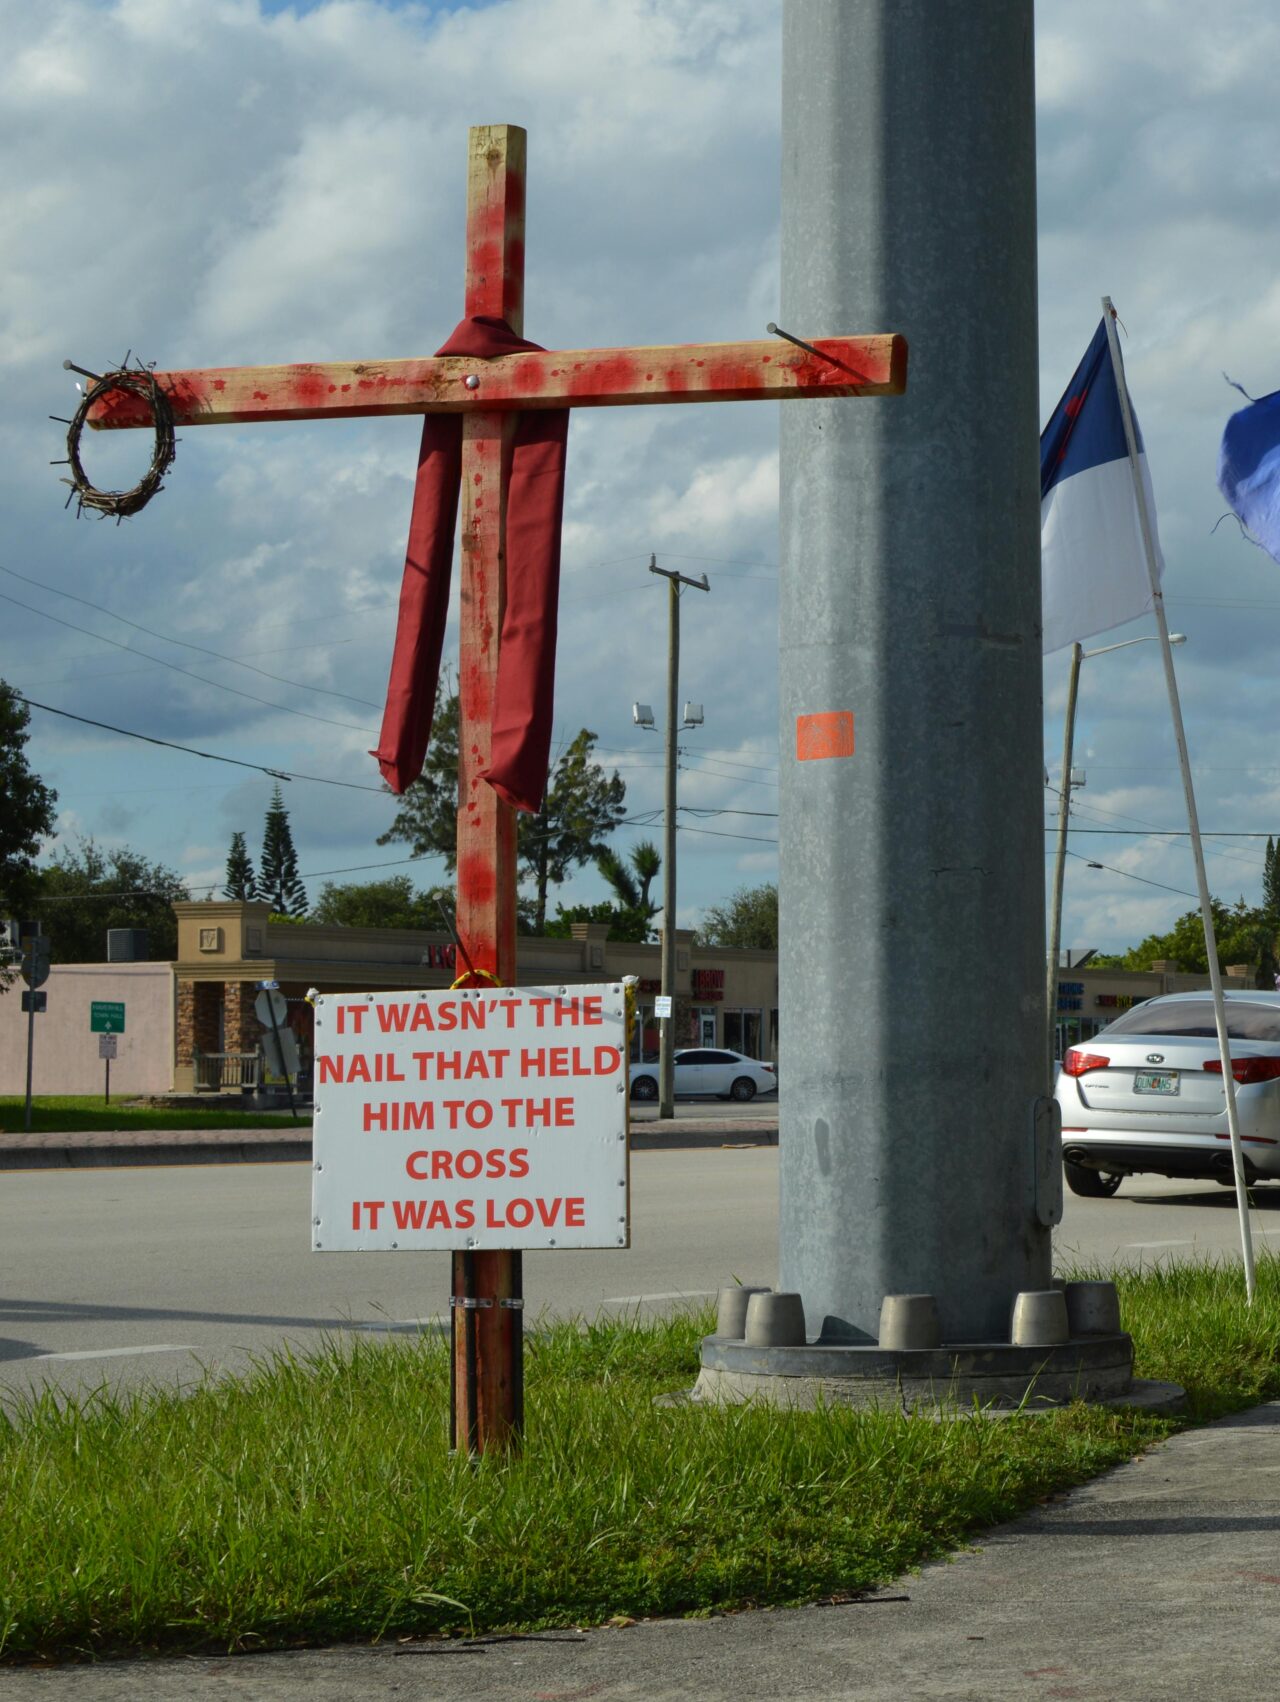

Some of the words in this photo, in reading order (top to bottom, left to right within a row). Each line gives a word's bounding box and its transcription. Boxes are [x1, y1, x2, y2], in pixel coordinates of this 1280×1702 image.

[336, 1005, 369, 1035] IT
[376, 998, 523, 1033] WASN'T
[529, 996, 604, 1028] THE
[319, 1053, 405, 1084] NAIL
[412, 1048, 511, 1081] THAT
[520, 1045, 621, 1078] HELD
[363, 1100, 434, 1133] HIM
[442, 1099, 494, 1130] TO
[500, 1096, 575, 1129] THE
[405, 1147, 530, 1181] CROSS
[351, 1201, 385, 1231] IT
[393, 1199, 476, 1230] WAS
[486, 1196, 586, 1229] LOVE
